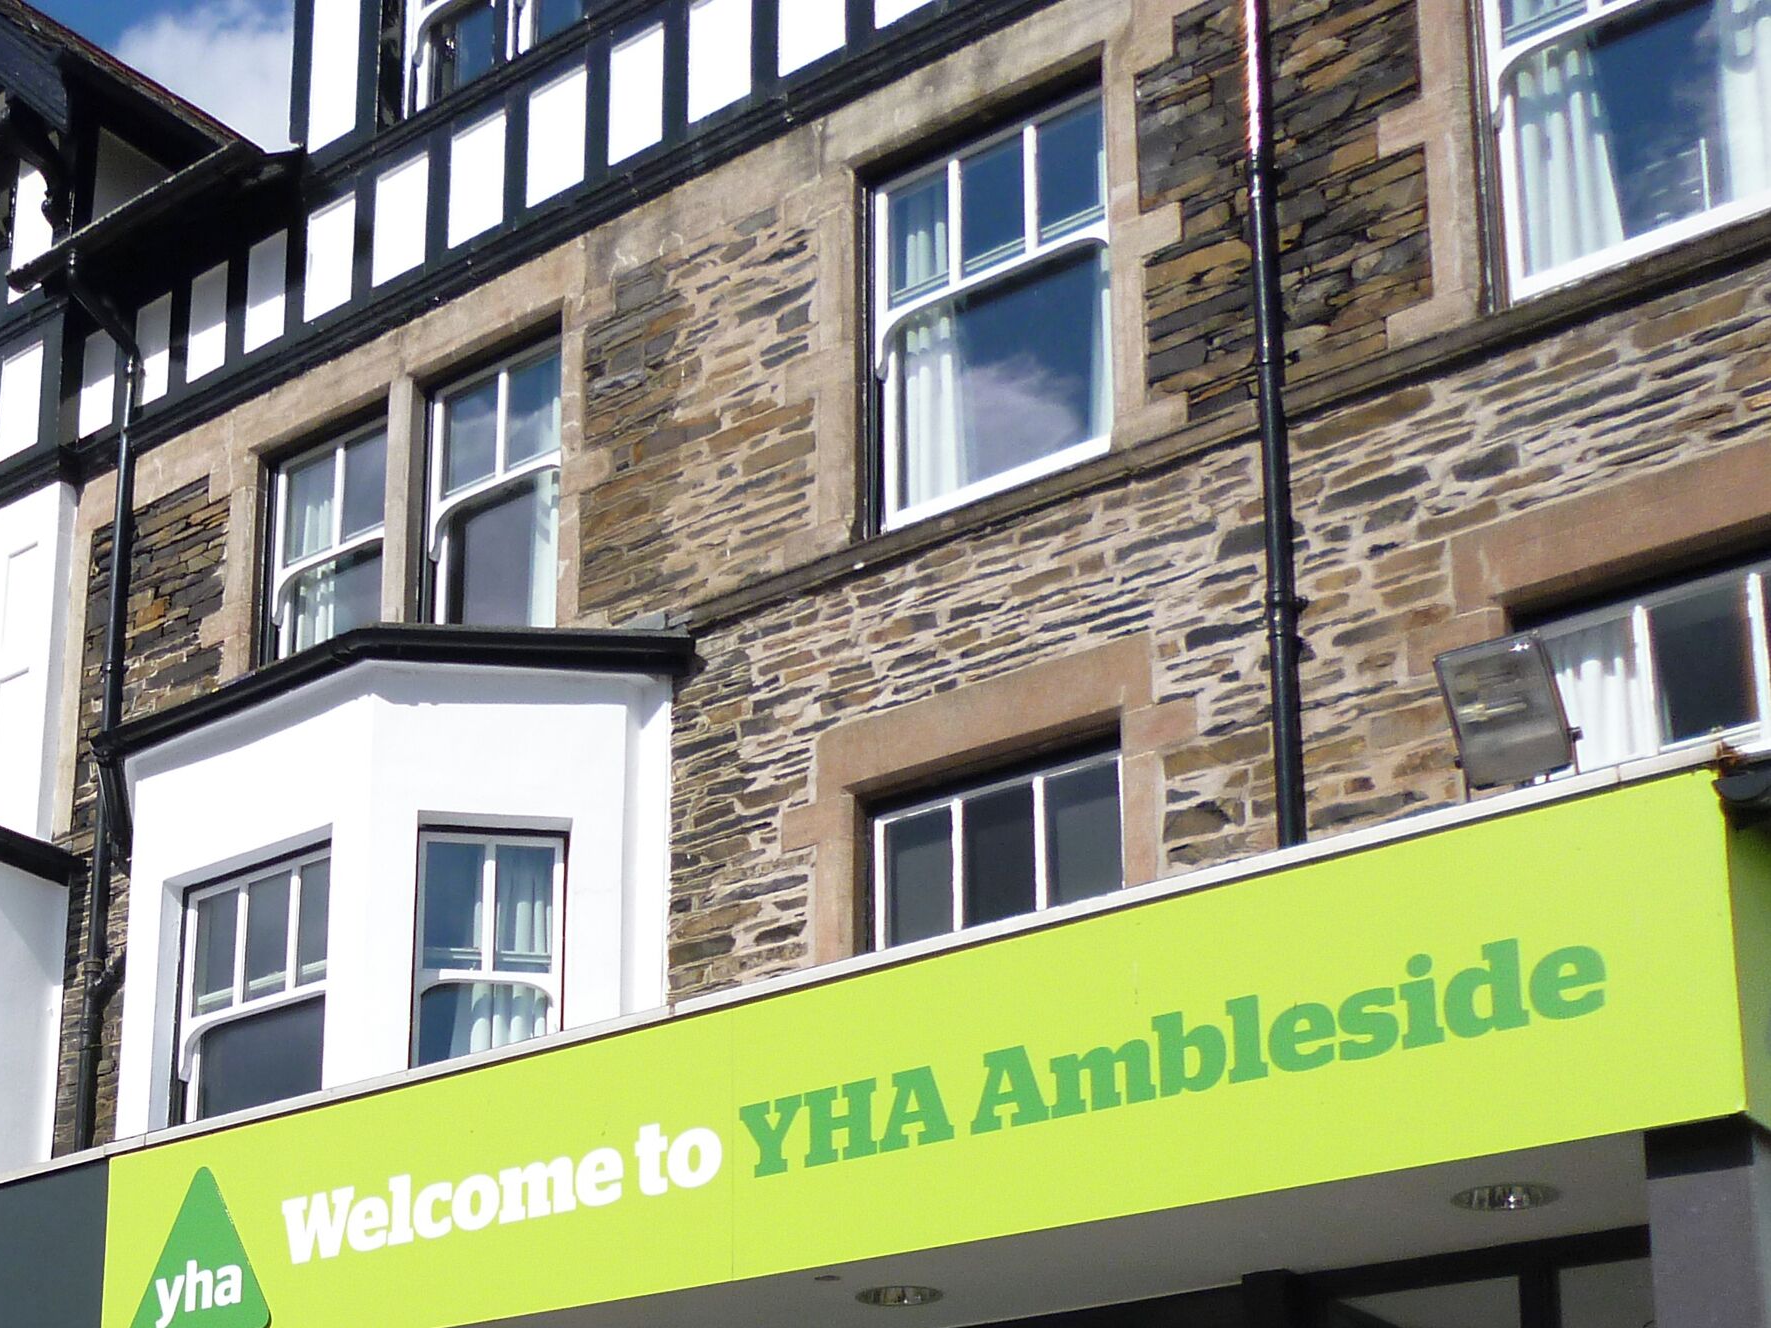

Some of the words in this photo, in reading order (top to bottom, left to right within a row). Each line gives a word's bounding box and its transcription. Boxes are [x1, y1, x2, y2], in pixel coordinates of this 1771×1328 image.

[281, 1146, 624, 1264] Welcome
[634, 1122, 723, 1198] to
[738, 1065, 956, 1179] YHA
[970, 938, 1607, 1136] Ambleside
